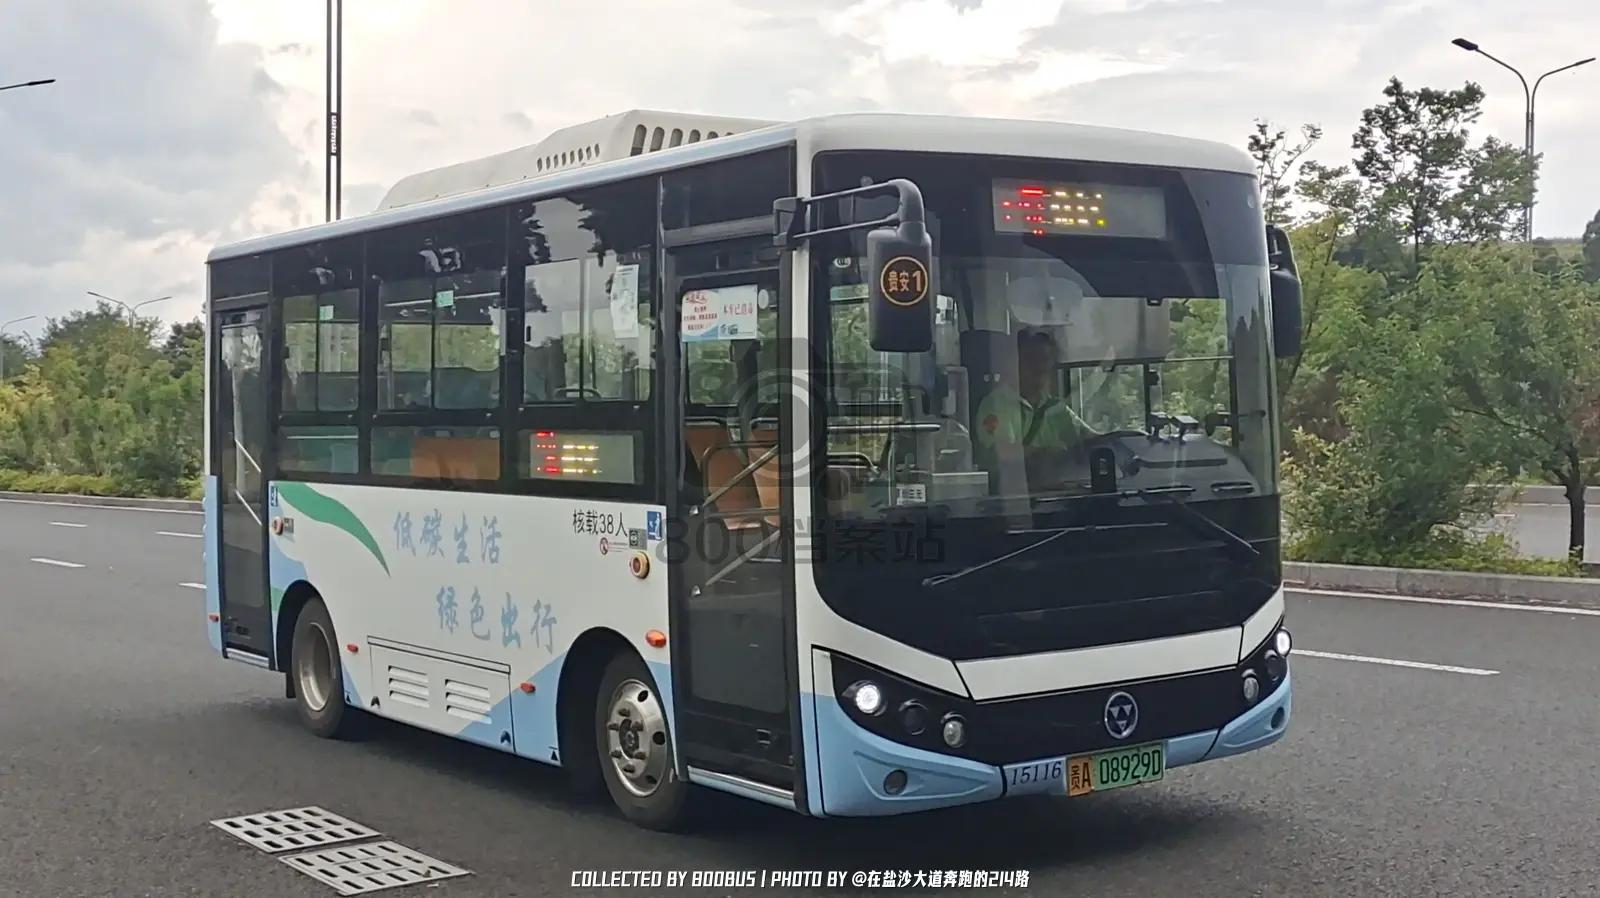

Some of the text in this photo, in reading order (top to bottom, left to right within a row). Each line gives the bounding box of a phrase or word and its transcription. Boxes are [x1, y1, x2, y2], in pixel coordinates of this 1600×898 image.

[888, 270, 922, 293] 贵安1
[393, 508, 502, 565] 低碳生活
[572, 509, 628, 537] 核载38人
[436, 586, 558, 656] 绿色出行
[1011, 761, 1062, 786] 15116
